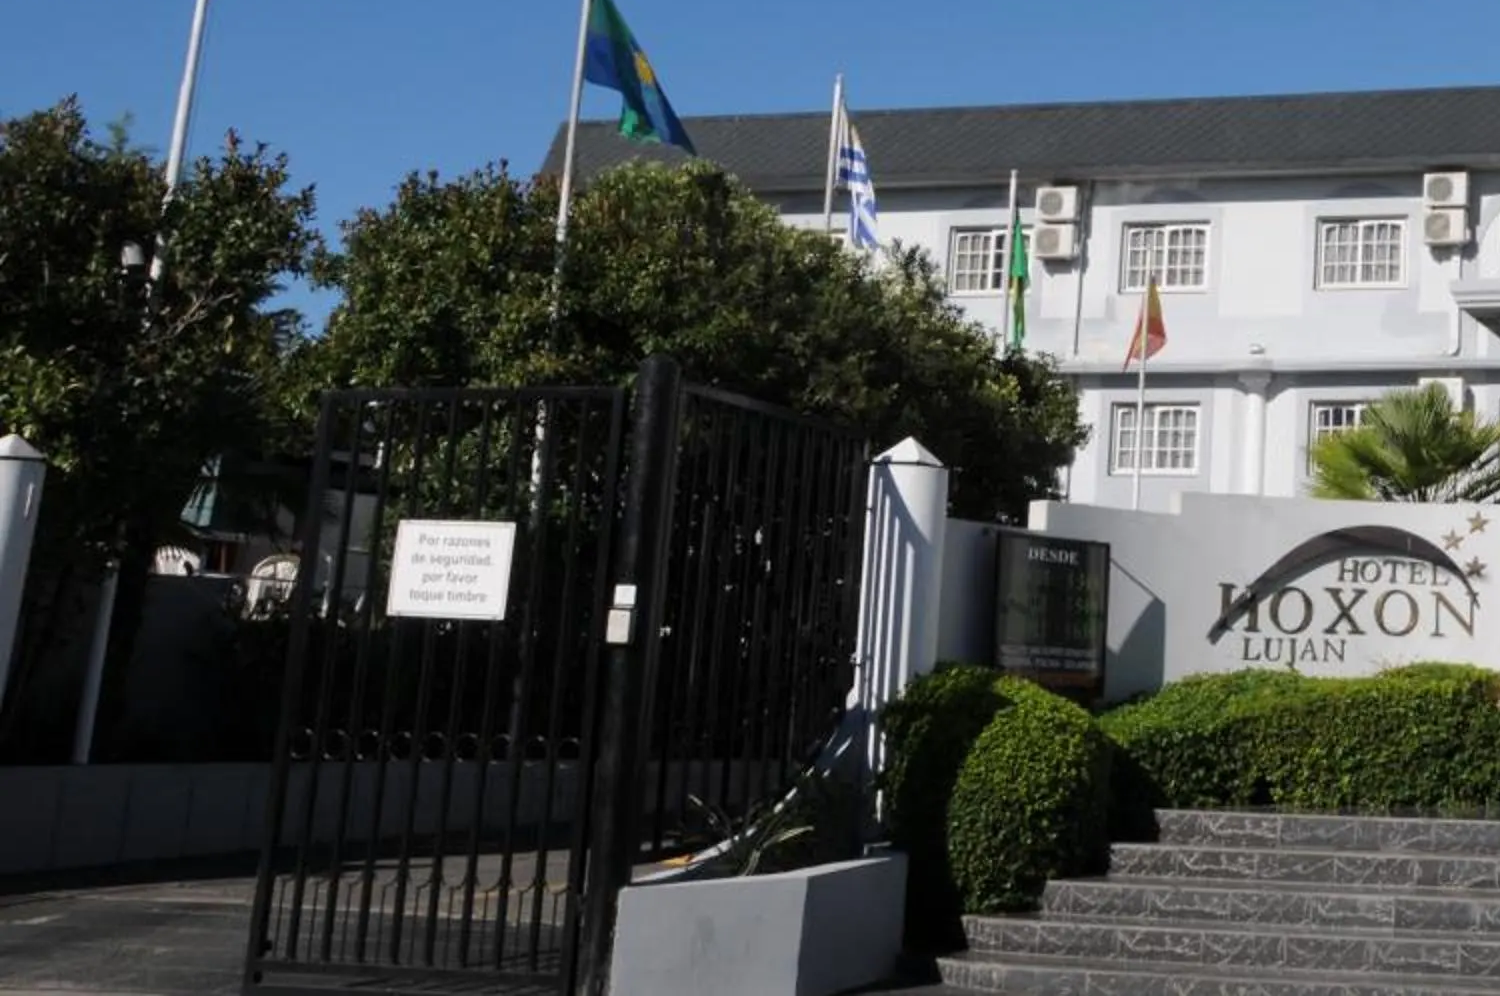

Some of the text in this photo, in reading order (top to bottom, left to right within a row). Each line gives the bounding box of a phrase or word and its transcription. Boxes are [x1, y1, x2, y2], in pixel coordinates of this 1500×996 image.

[419, 534, 491, 548] Por razones
[411, 552, 426, 565] de
[1027, 546, 1079, 565] DESDE
[422, 571, 478, 584] por favor
[1337, 557, 1451, 586] HOTEL
[409, 588, 488, 603] toque timbre
[1218, 582, 1479, 638] HOXON
[1241, 636, 1347, 669] LUJAN
